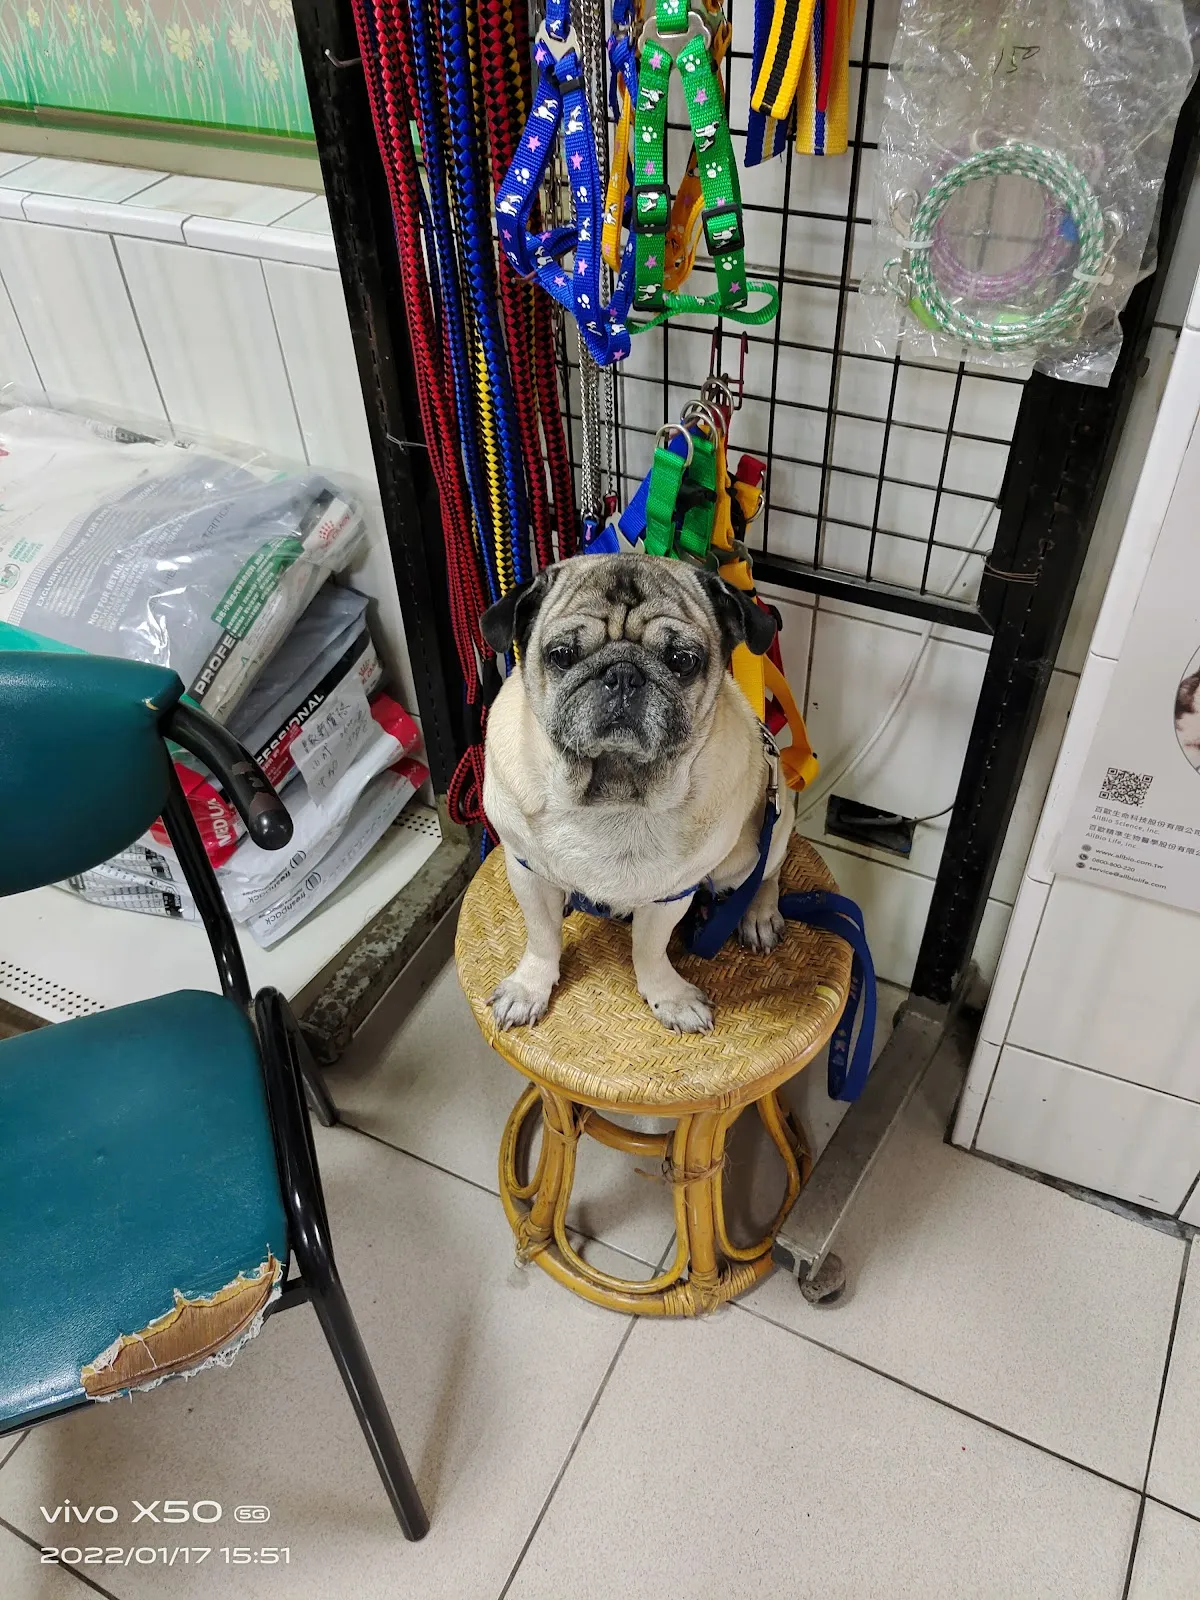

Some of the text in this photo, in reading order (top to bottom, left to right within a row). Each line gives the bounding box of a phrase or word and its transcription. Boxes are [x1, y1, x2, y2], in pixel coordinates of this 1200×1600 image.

[35, 555, 70, 608] EXCLUSIVELY
[84, 520, 99, 538] FOR
[87, 607, 102, 625] NOT
[97, 590, 111, 608] FOR
[105, 562, 125, 592] RETAIL
[193, 632, 238, 695] PROFE
[1085, 832, 1107, 841] AllBio
[1108, 838, 1124, 846] Life,
[1091, 814, 1160, 835] AllBio Science, Inc.
[1095, 849, 1164, 870] www.allbio.com.tw
[263, 890, 307, 927] freshpack
